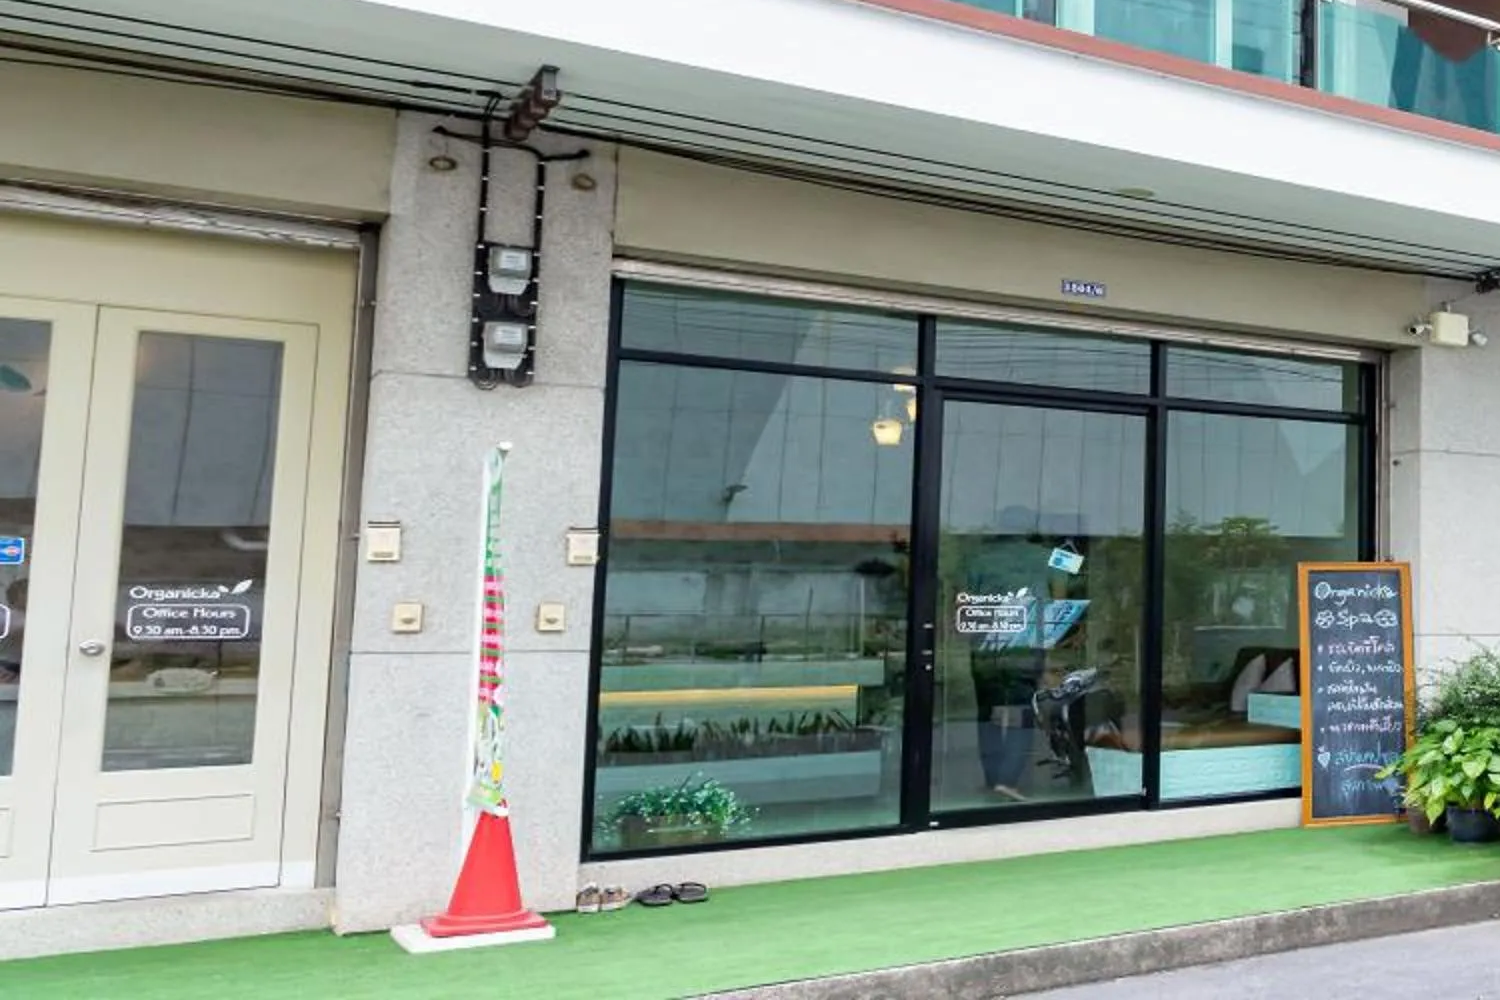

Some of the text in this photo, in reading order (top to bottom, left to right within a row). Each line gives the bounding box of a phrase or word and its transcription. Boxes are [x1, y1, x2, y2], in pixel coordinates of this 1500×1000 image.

[129, 585, 221, 600] Organicka
[143, 607, 237, 619] Office Hours
[1336, 608, 1373, 631] Spa
